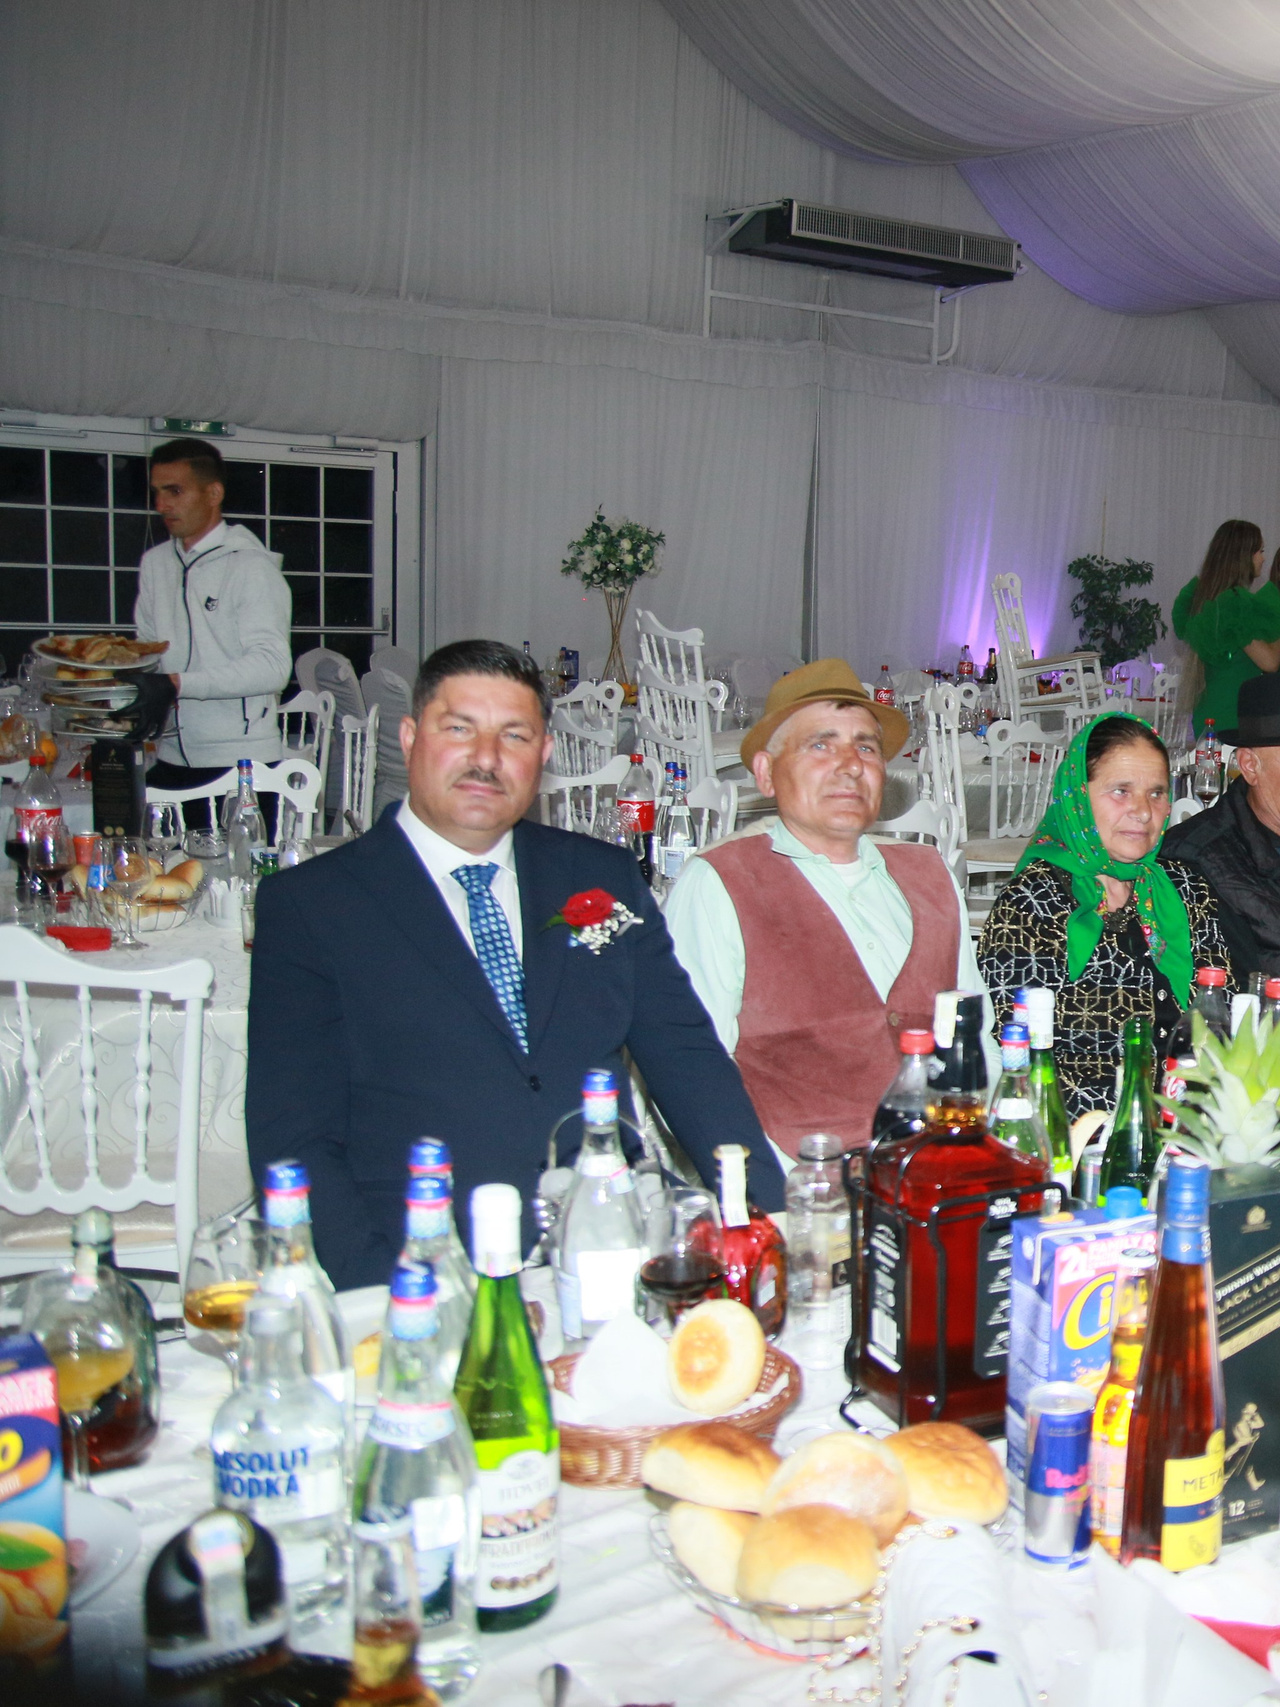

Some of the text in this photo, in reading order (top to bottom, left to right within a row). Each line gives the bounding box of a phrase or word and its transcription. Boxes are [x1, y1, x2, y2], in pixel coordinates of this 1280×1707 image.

[1063, 1271, 1117, 1350] Ci
[1216, 1287, 1252, 1315] LACK
[1183, 1468, 1225, 1493] META
[1228, 1499, 1246, 1517] 12
